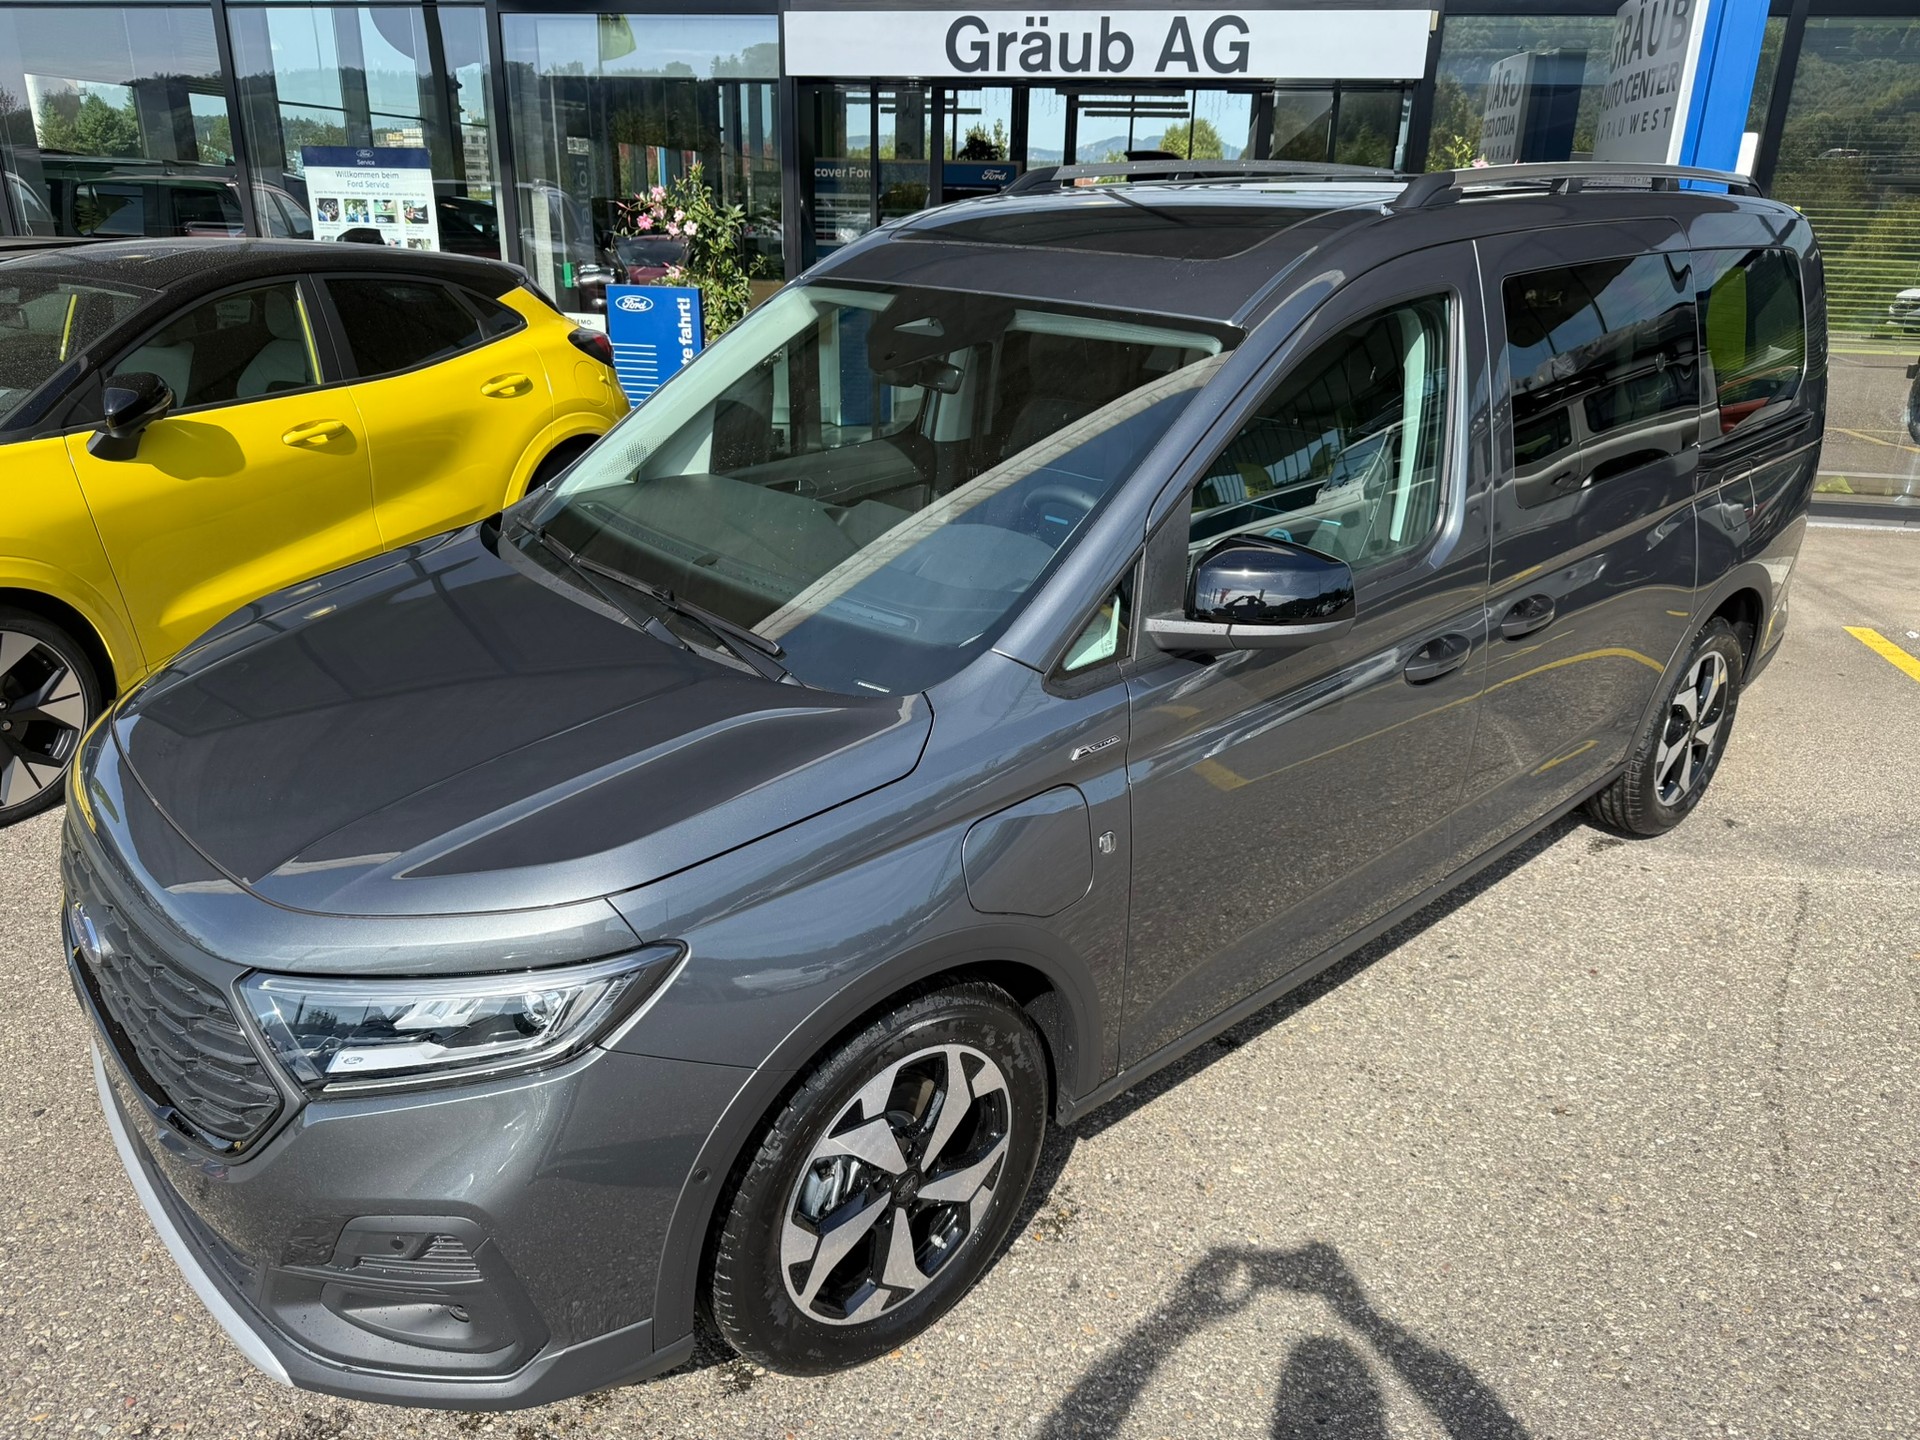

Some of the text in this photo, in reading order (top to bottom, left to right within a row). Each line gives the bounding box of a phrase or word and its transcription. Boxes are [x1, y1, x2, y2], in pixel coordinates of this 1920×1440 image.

[945, 14, 1250, 74] Gräub AG
[1609, 0, 1690, 74] GRÄUB
[1624, 61, 1680, 104] CENTER
[1629, 106, 1672, 135] WEST
[335, 170, 400, 179] Willkommen beim
[346, 180, 390, 189] Ford Service
[981, 168, 1007, 181] Ford
[620, 297, 650, 311] Ford
[677, 297, 693, 346] fahrt!
